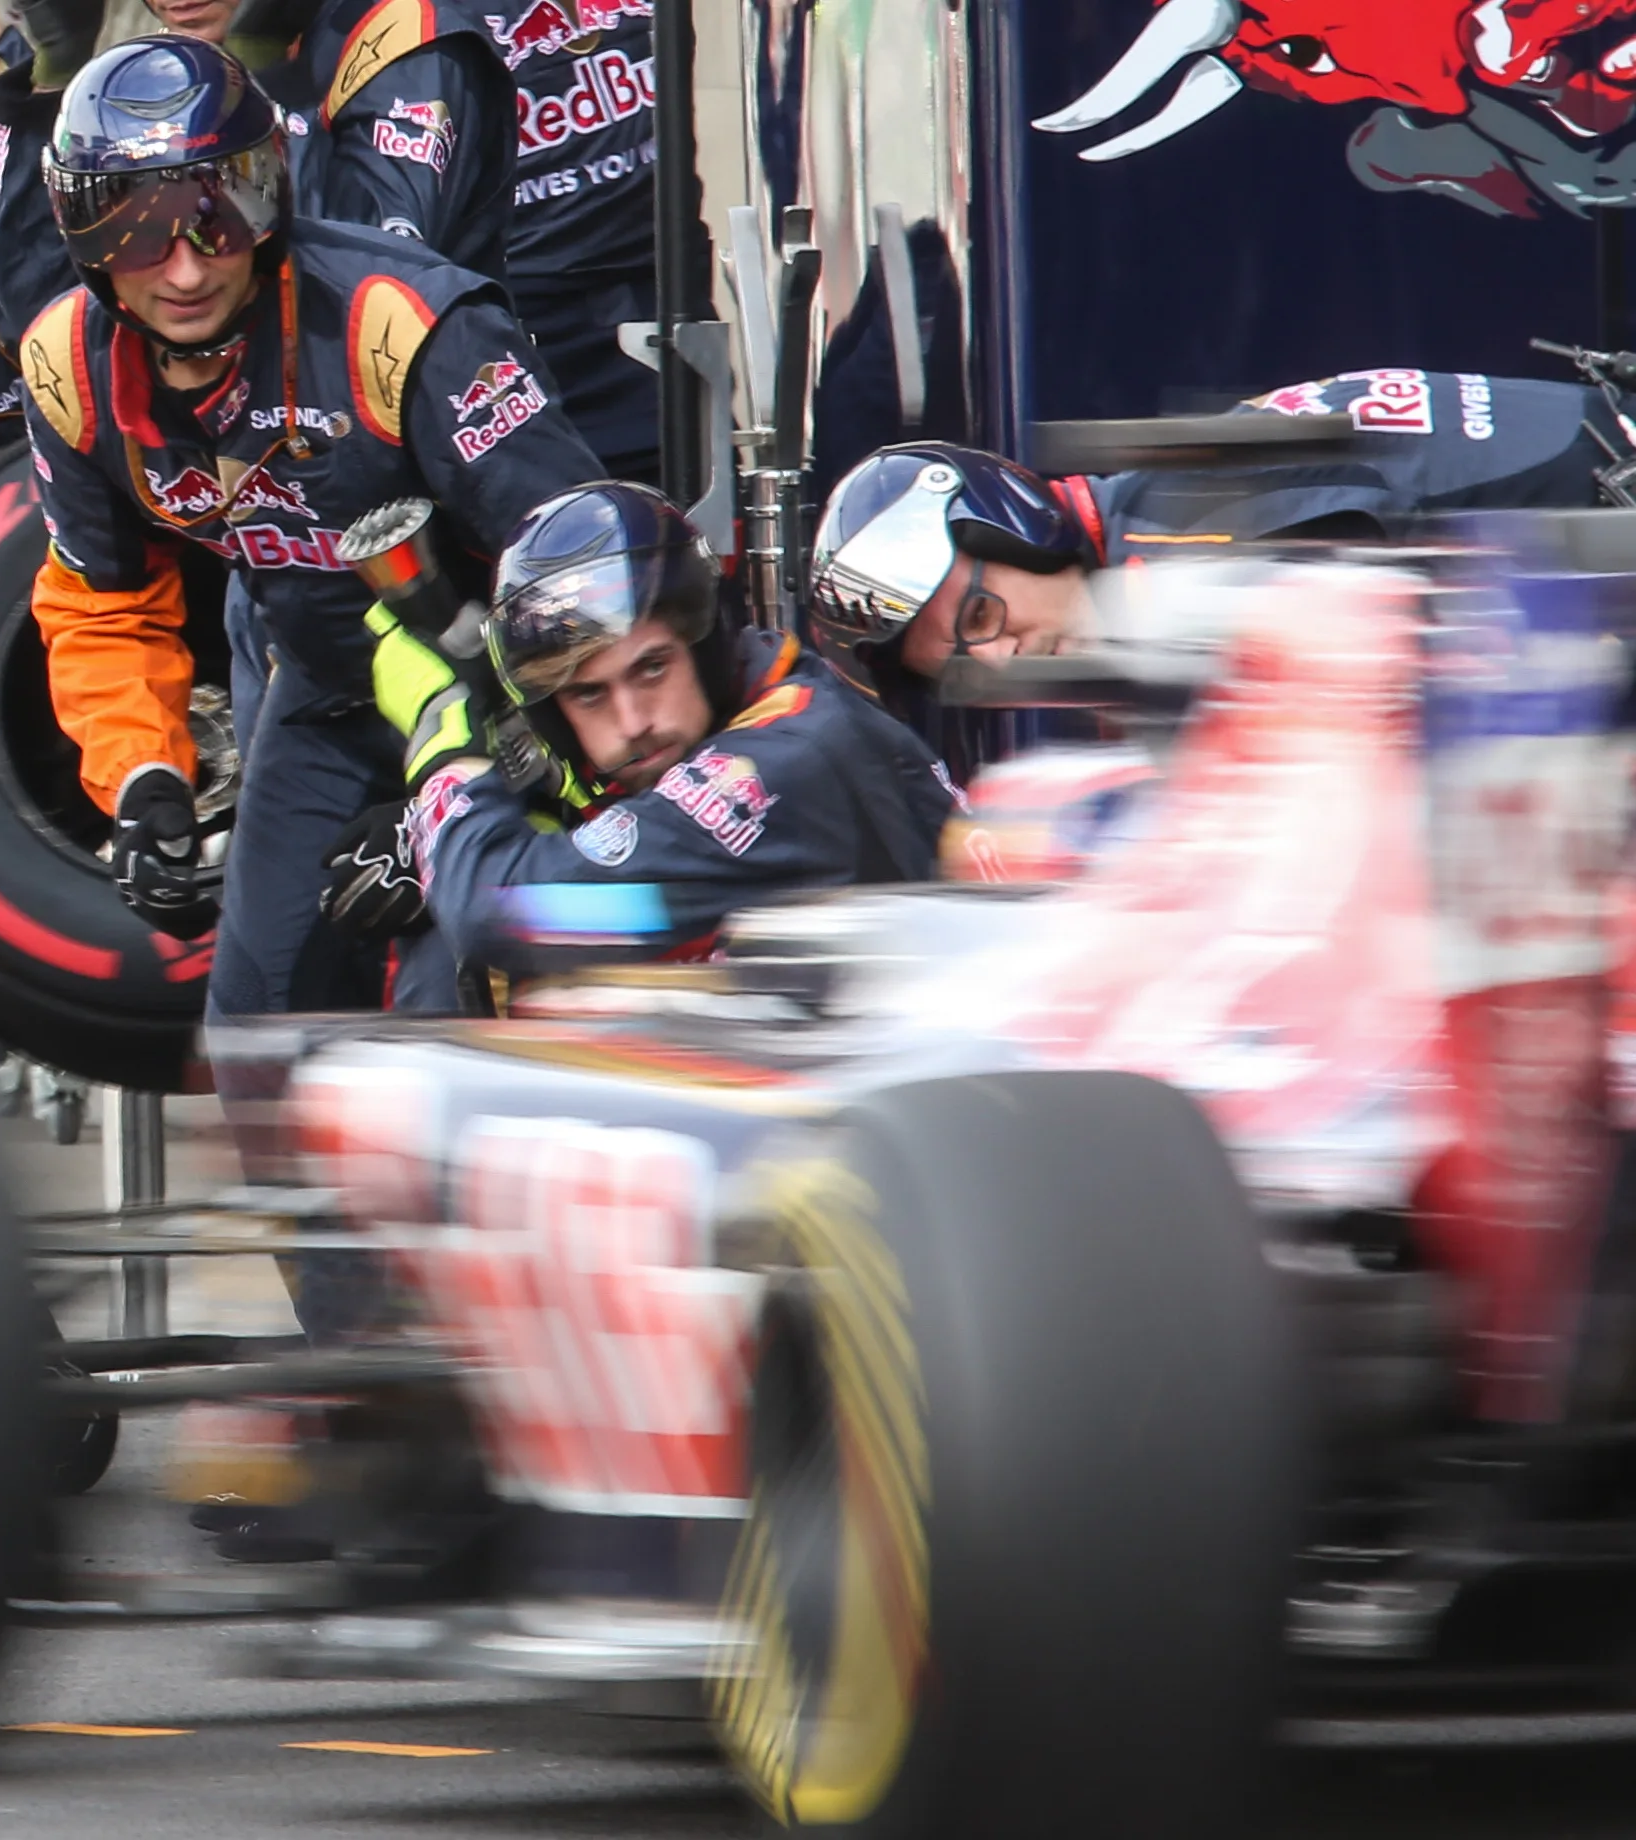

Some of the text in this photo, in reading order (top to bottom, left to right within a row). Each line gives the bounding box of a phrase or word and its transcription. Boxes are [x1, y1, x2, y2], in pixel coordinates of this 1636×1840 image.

[594, 51, 656, 121] Bu
[374, 119, 435, 164] Red
[250, 406, 334, 437] SAPNDA
[452, 374, 548, 463] Red Bul
